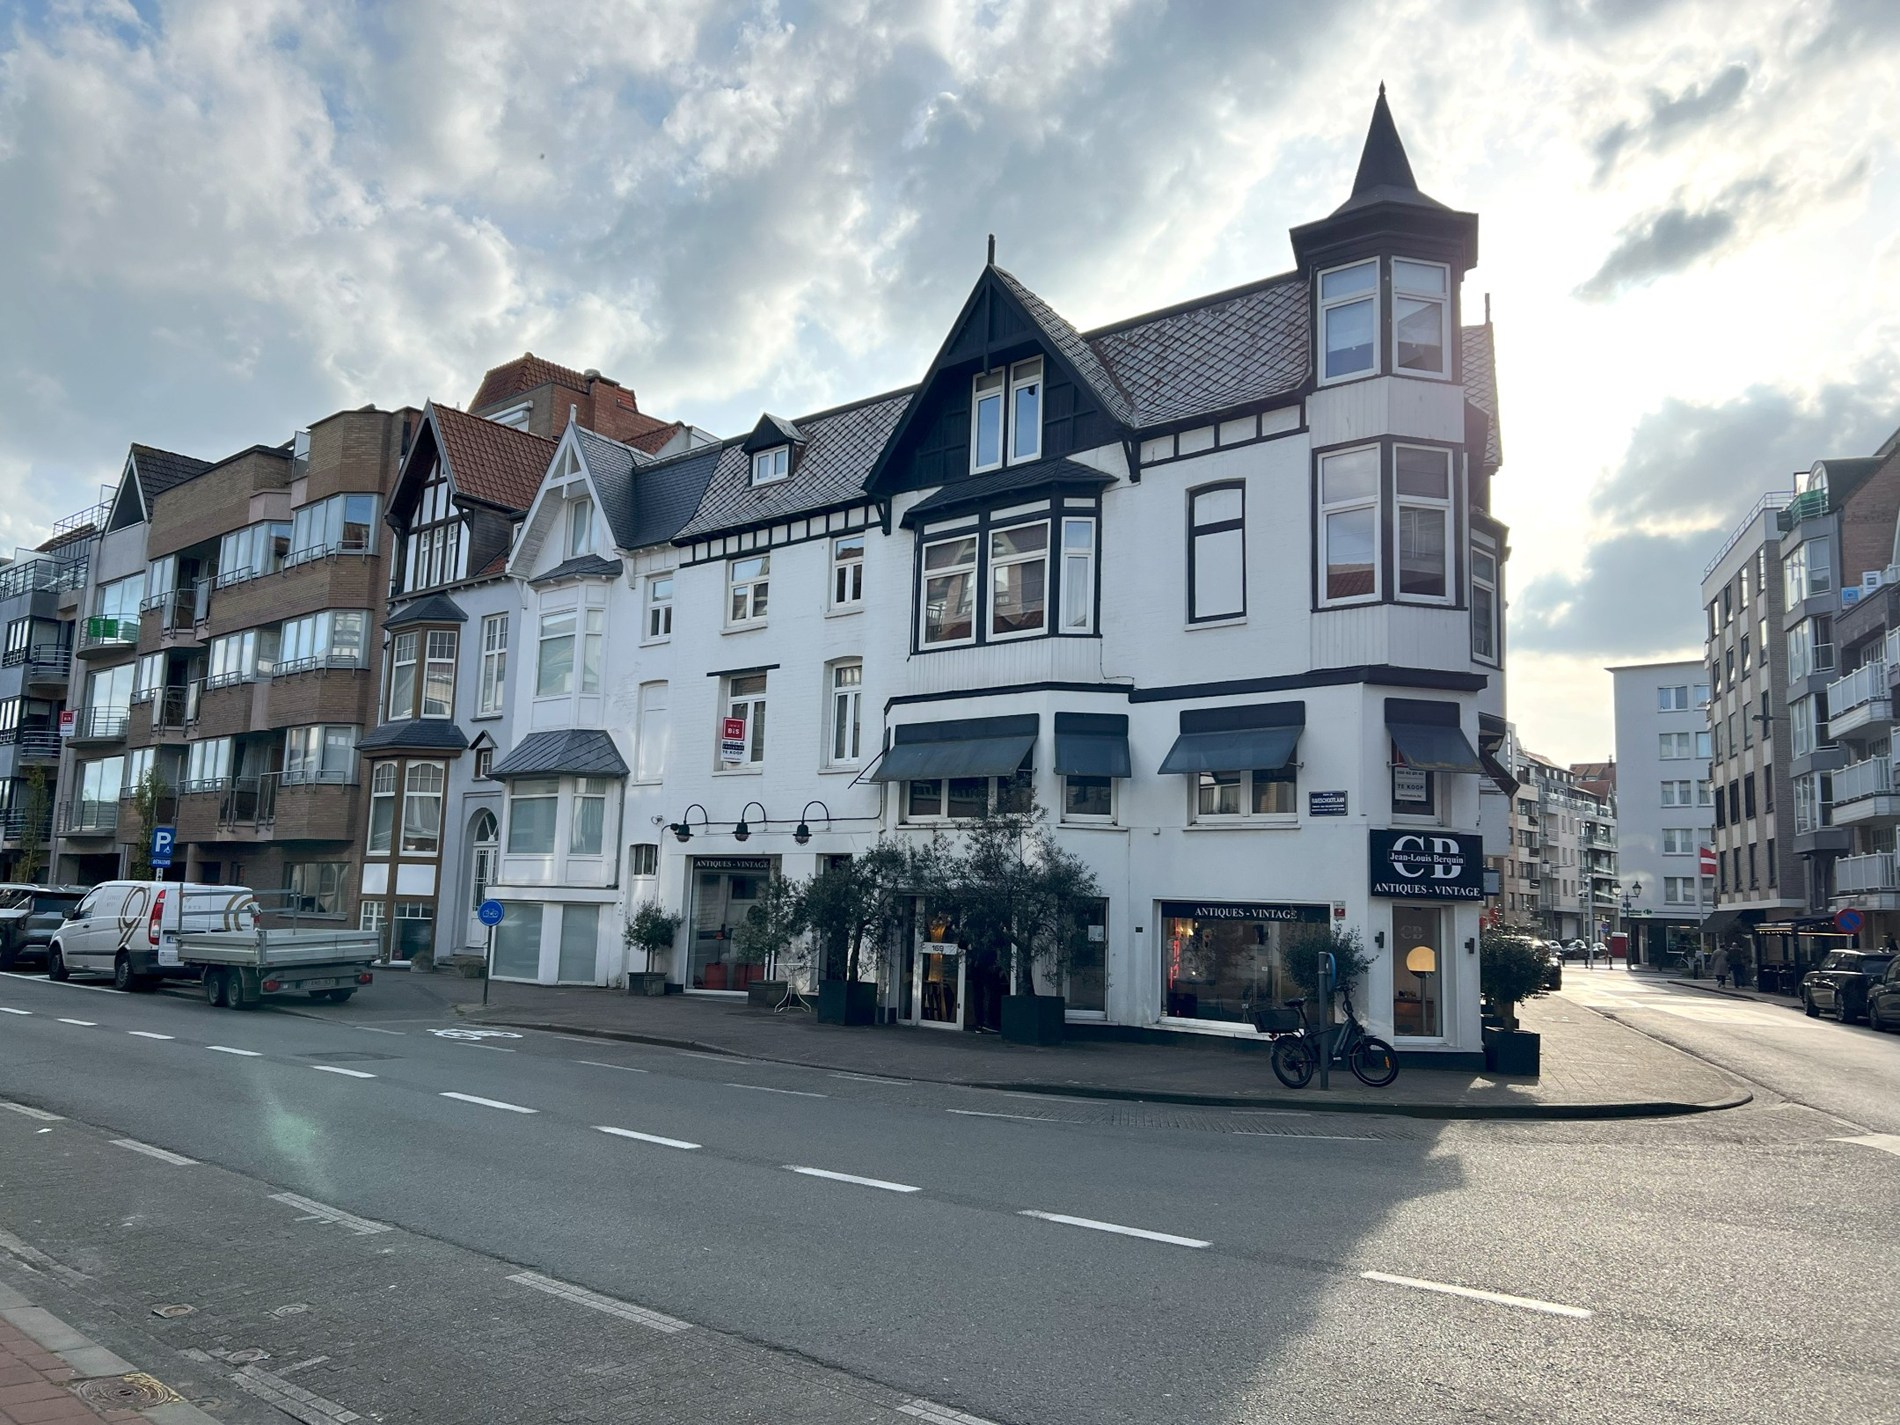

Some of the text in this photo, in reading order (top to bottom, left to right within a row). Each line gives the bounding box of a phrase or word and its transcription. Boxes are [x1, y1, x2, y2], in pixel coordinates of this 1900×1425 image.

[155, 832, 171, 852] P
[695, 860, 732, 868] ANTIQUES
[1389, 852, 1464, 865] Jean-Louis Berquin
[1374, 882, 1427, 895] ANTIQUES
[1434, 886, 1480, 897] VINTAGE
[1195, 907, 1244, 918] ANTIQUES
